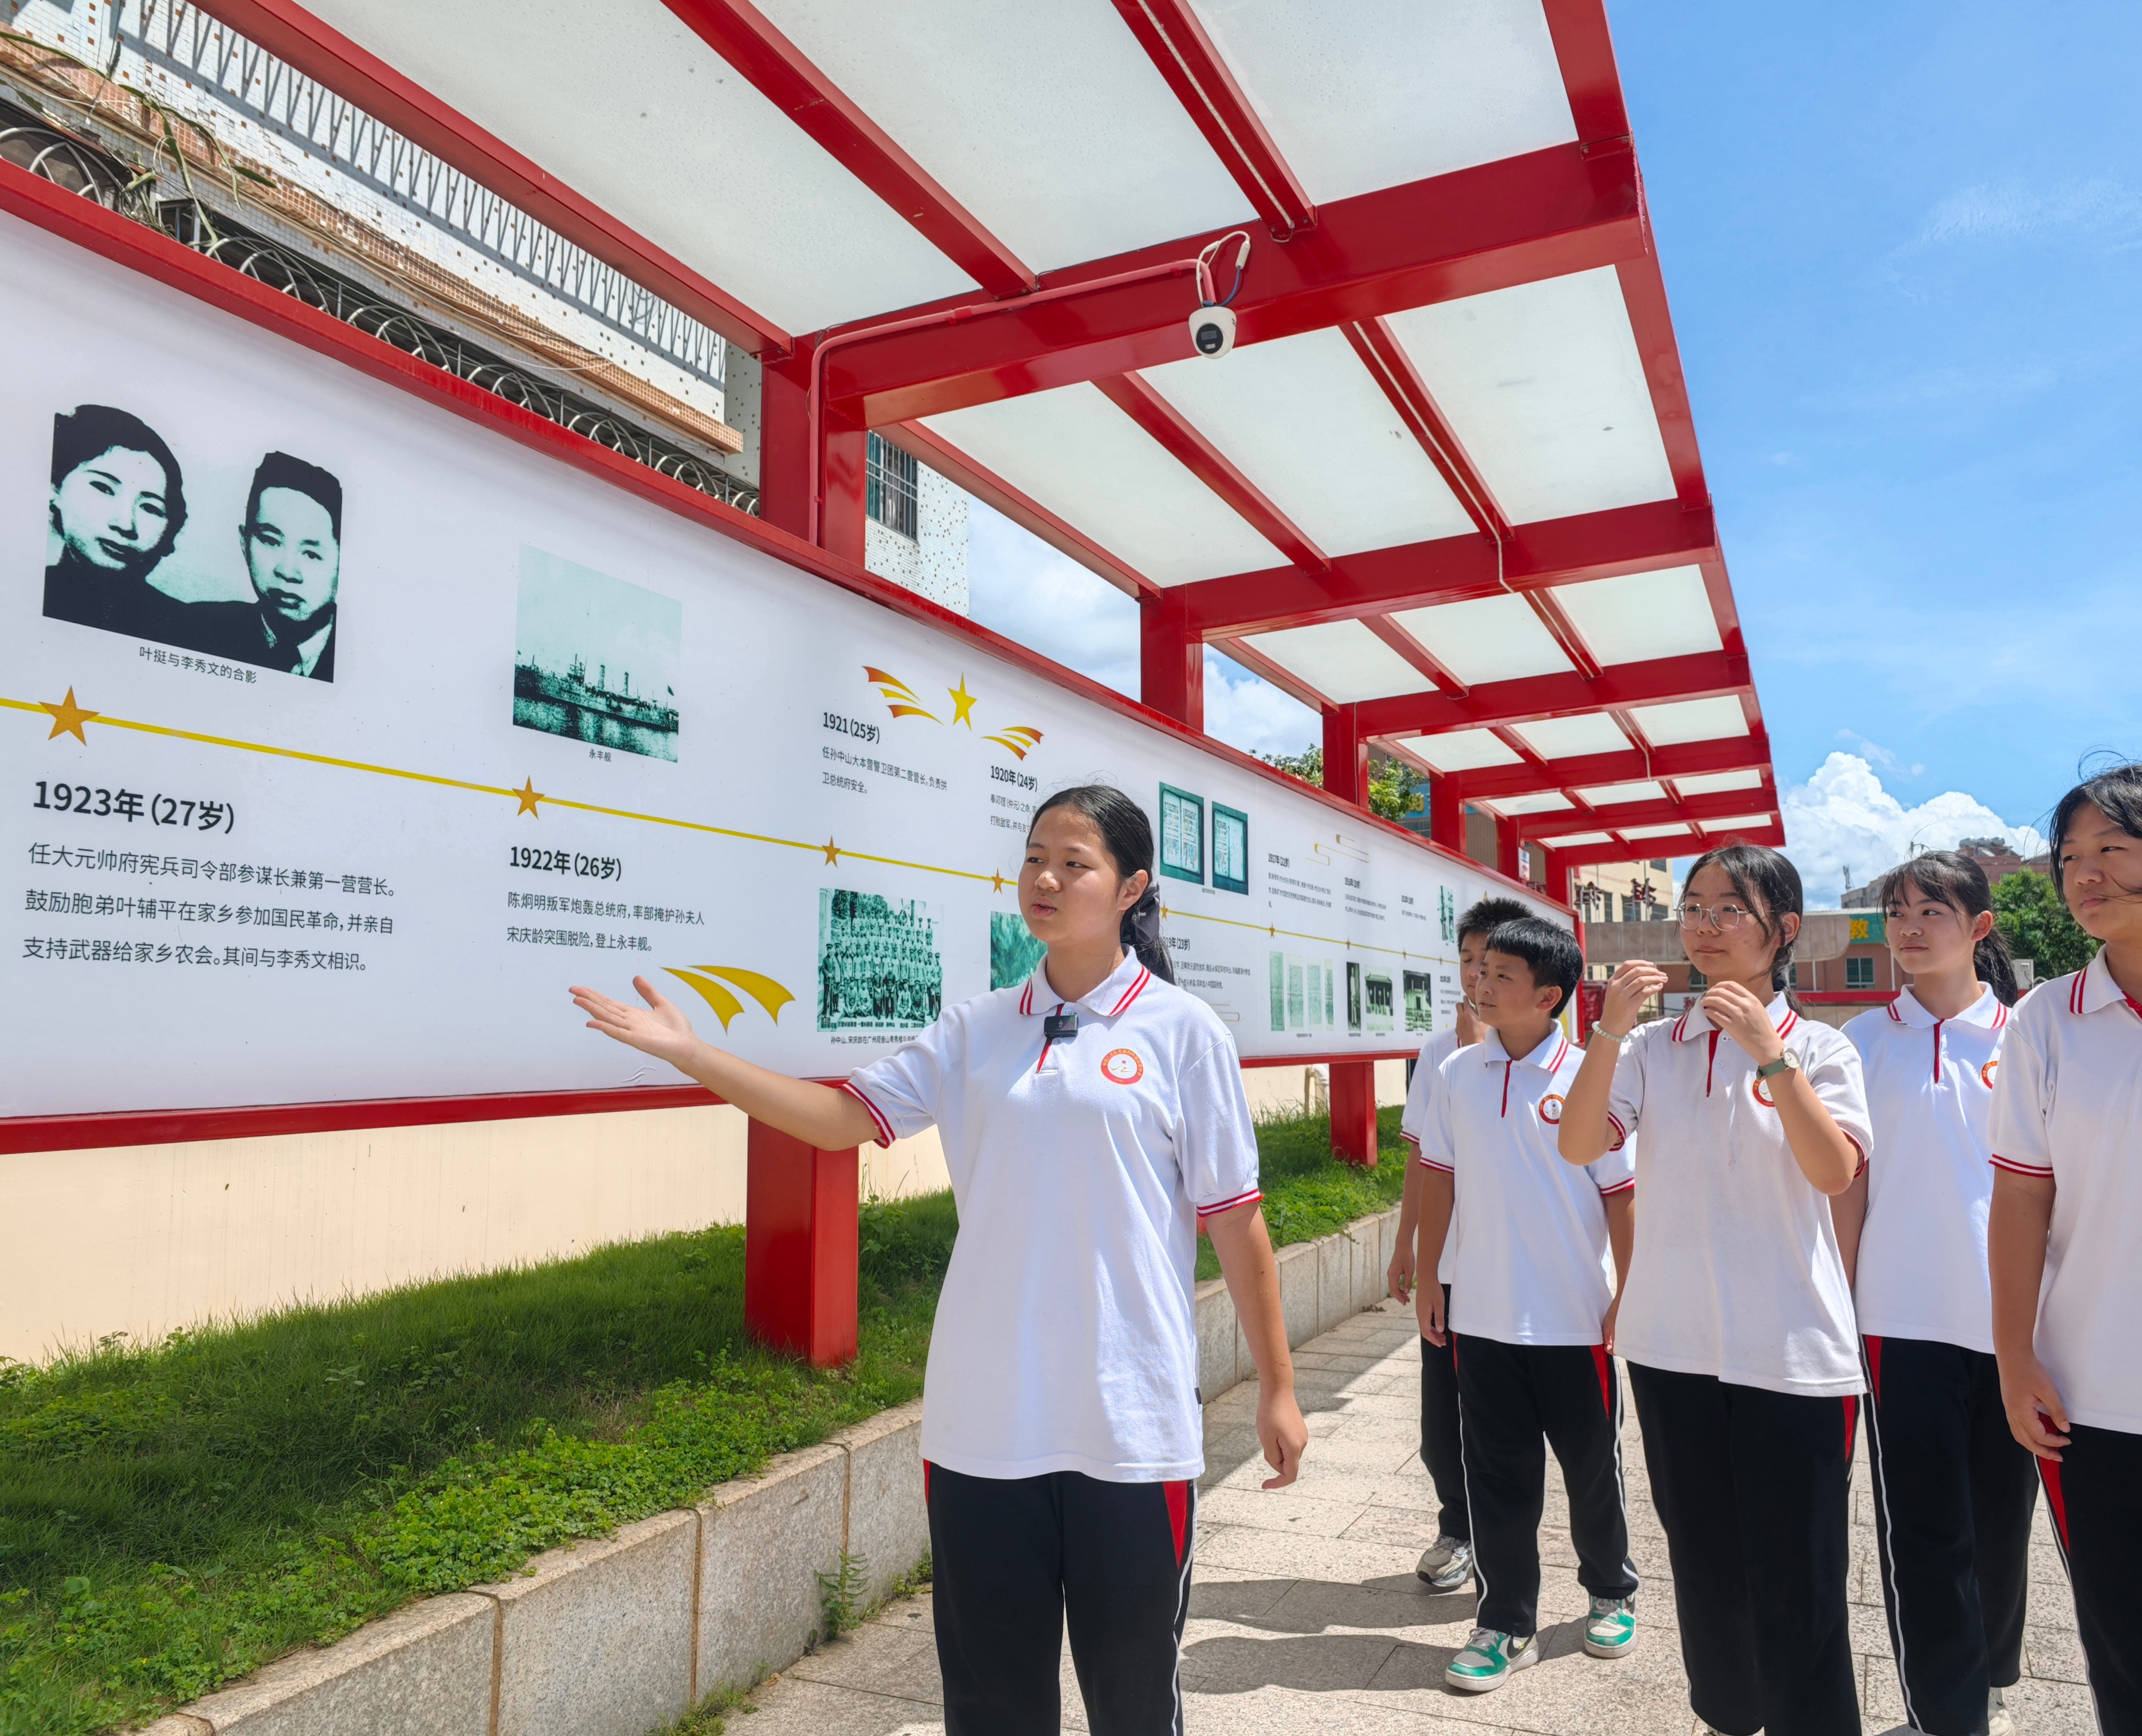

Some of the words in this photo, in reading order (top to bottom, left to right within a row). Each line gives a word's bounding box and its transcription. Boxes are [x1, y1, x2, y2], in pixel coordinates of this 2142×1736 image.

[139, 646, 257, 684] 叶挺与李秀文的合影
[823, 712, 880, 744] 1921（25岁）
[589, 748, 611, 763] 永丰舰
[822, 772, 868, 794] 卫总统府安全。
[990, 765, 1038, 792] 1920年（24岁）
[33, 781, 234, 834] 1923年（27岁）
[29, 842, 394, 897] 任大元帅府宪兵司令部参谋长兼第一营营长。
[510, 846, 622, 882] 1922年（26岁）
[25, 889, 393, 934] 鼓励胞弟叶辅平在家乡参加国民革命，并亲自
[508, 891, 705, 926] 陈炯明叛军炮轰总统府，率部掩护孙夫人
[22, 936, 366, 971] 支持武器给家乡农会。其间与李秀文相识。
[507, 926, 652, 952] 宋庆龄突围脱险，登上永丰舰。
[830, 1035, 919, 1044] 孙中山、宋庆龄在广州观音山粤秀楼与总统
